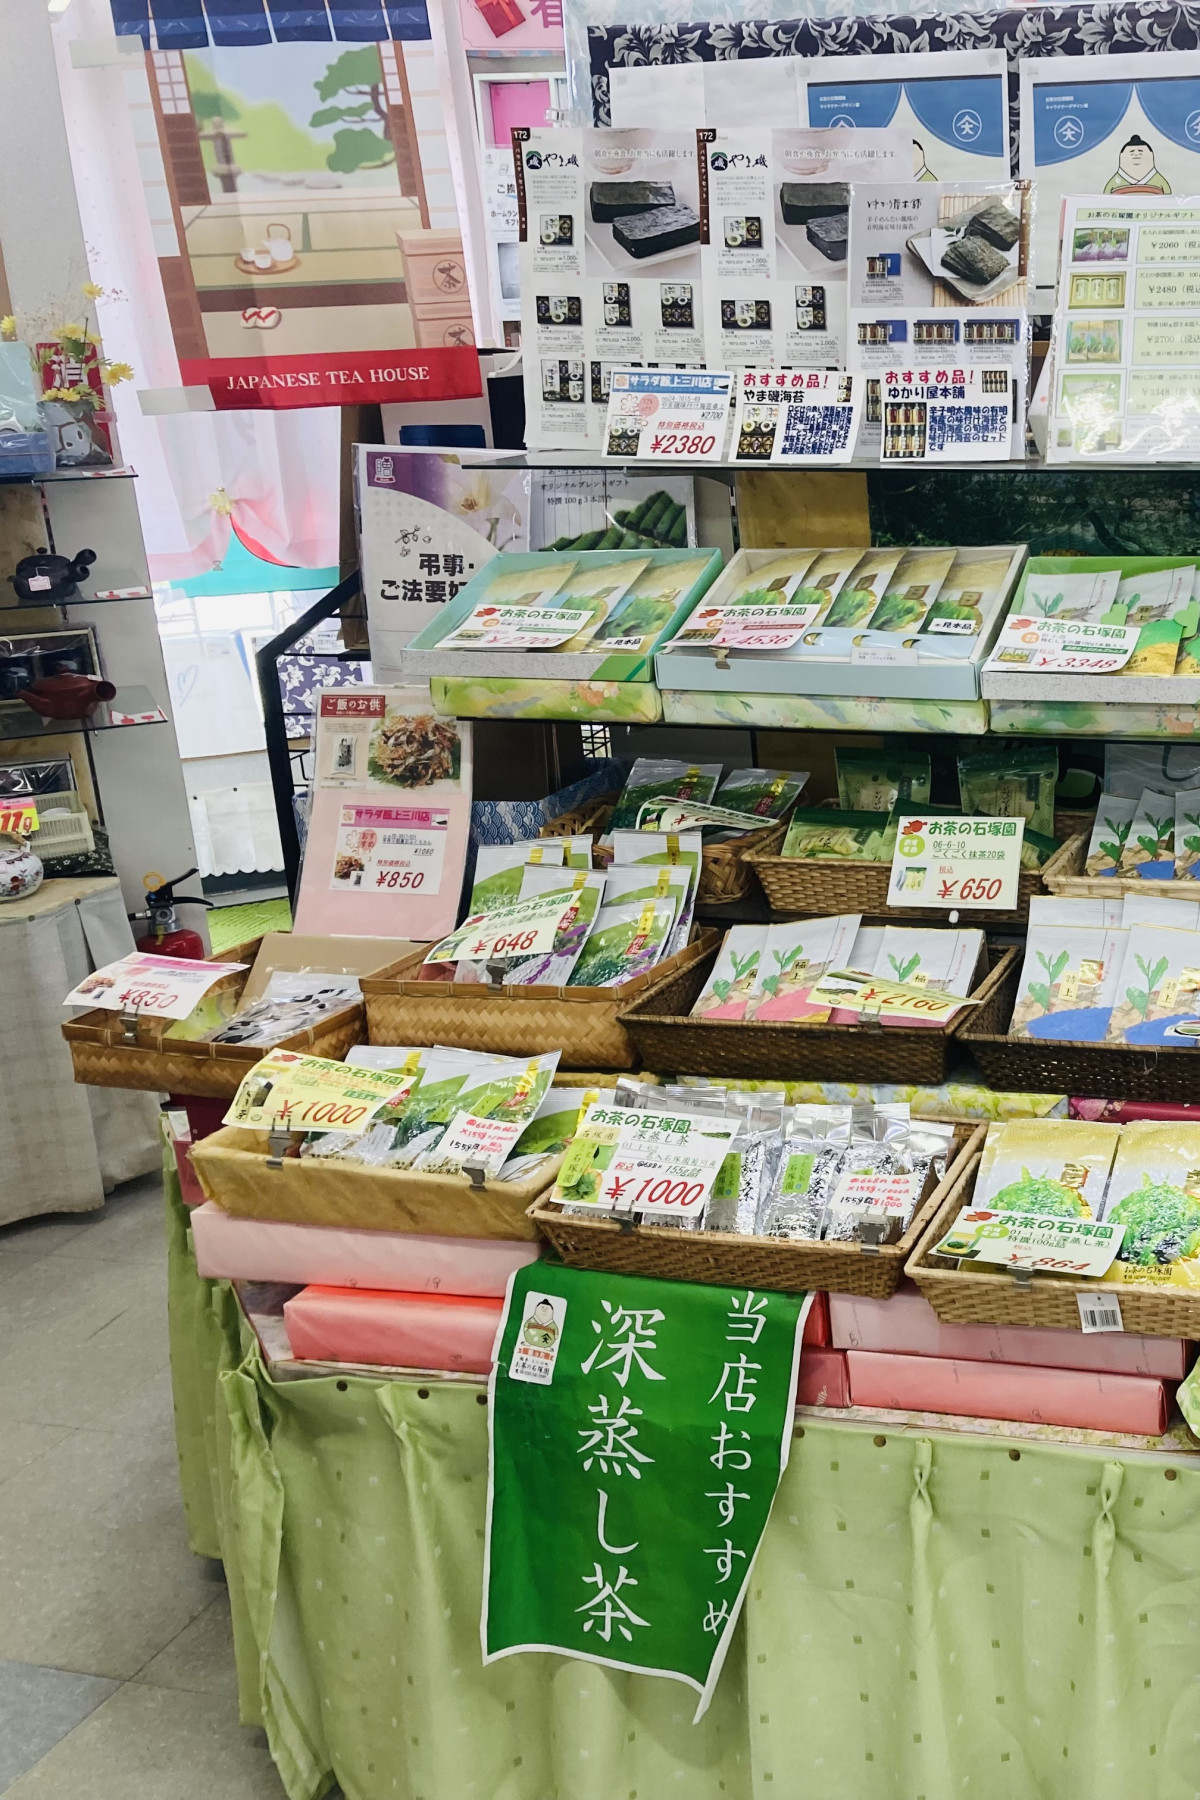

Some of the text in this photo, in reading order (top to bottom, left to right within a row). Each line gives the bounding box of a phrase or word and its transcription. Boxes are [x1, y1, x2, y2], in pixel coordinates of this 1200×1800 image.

[513, 130, 528, 140] 172
[699, 131, 714, 141] 172
[227, 366, 430, 390] JAPANESE TEA HOUSE
[743, 373, 828, 388] おすすめ品!
[885, 370, 975, 385] おすすめ品!
[744, 390, 805, 403] やま磯海苔
[888, 386, 966, 400] ゆかり屋本舗
[650, 434, 716, 455] ¥2380
[500, 608, 582, 621] お茶の石塚園
[723, 606, 808, 618] お茶の石塚園
[717, 634, 794, 646] ¥4536
[1036, 621, 1127, 640] お茶の石塚園
[1034, 656, 1118, 670] ¥3348
[326, 698, 381, 712] ご飯のお供
[928, 820, 1017, 838] お茶の石塚園
[932, 839, 966, 850] 06-6-10
[376, 872, 425, 889] ¥850
[937, 877, 1002, 900] ¥650
[489, 893, 574, 921] お茶の石塚園
[470, 930, 539, 954] ¥648
[118, 988, 178, 1009] ¥850
[299, 1055, 405, 1087] お茶の石塚園
[277, 1099, 369, 1126] ¥1000
[590, 1108, 692, 1134] お茶の石塚園
[605, 1176, 706, 1207] ¥1000
[998, 1213, 1114, 1239] お茶の石塚園
[1003, 1253, 1092, 1272] ¥864
[573, 1299, 667, 1642] 深蒸し茶
[702, 1290, 768, 1637] 当店おすすめ
